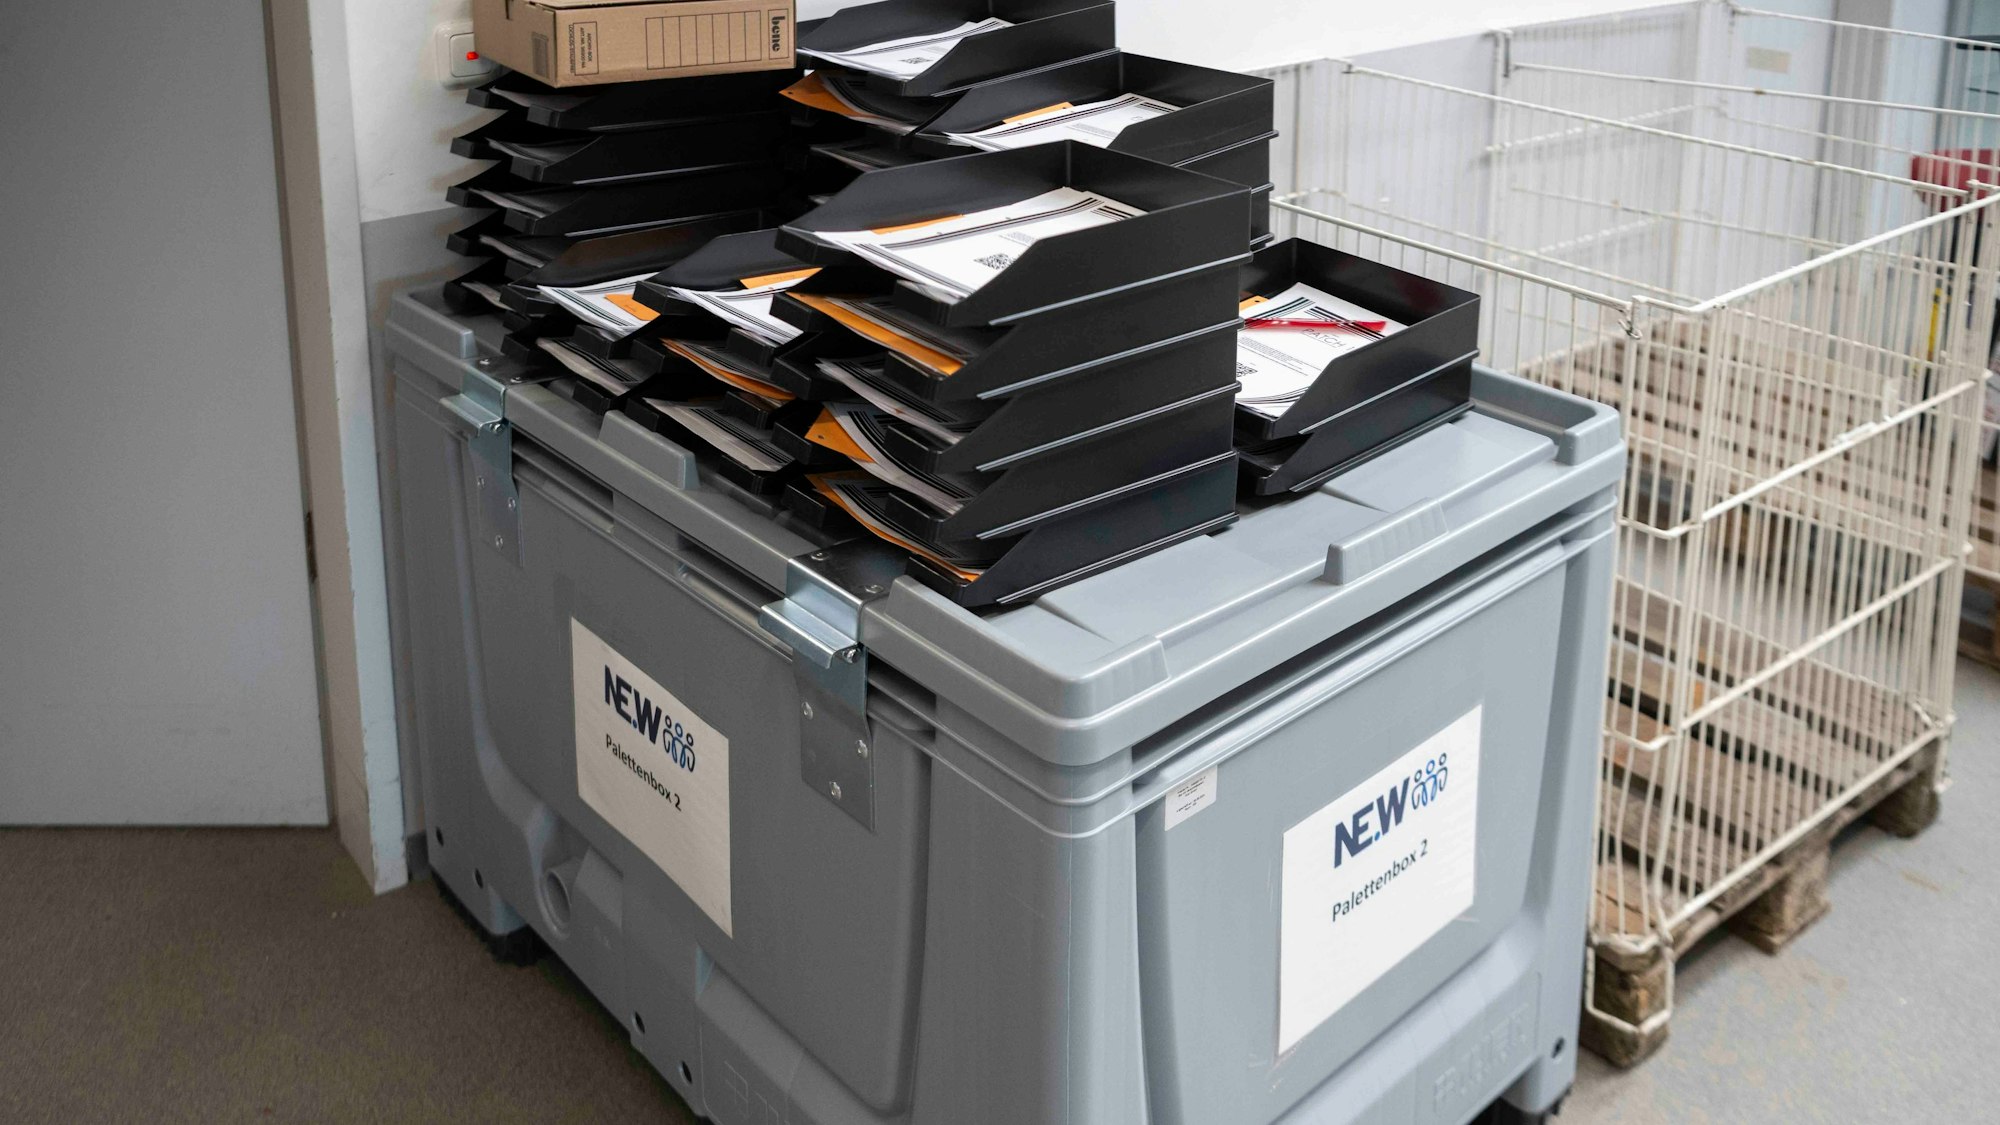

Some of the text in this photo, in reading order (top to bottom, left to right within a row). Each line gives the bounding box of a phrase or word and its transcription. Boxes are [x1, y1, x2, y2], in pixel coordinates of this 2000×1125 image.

[771, 15, 786, 52] bene
[606, 733, 682, 812] Palettenbox 2
[1332, 838, 1428, 922] Palettenbox 2
